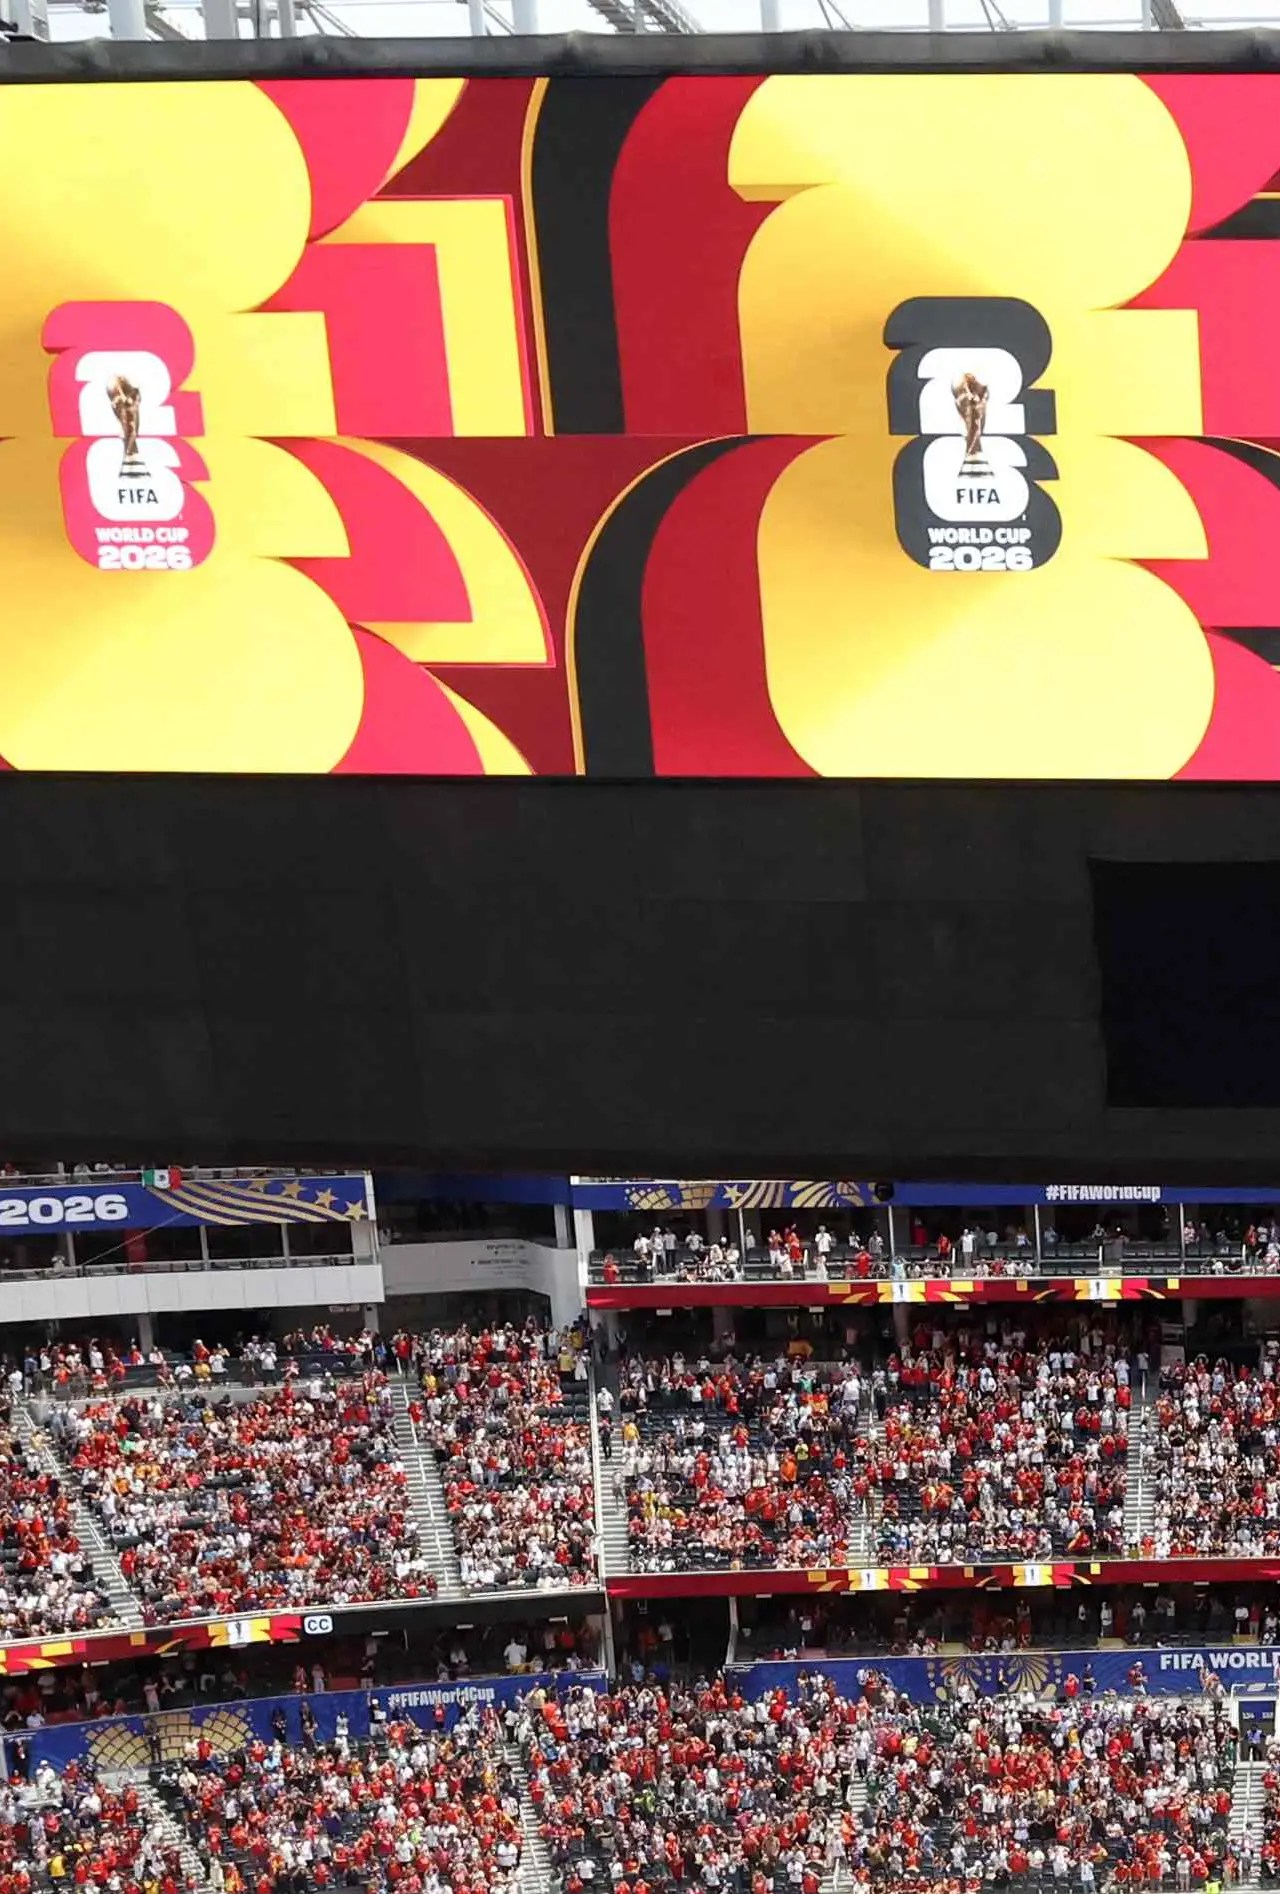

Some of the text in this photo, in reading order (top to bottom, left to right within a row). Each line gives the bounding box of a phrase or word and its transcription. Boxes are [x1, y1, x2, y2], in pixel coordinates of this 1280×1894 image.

[117, 489, 159, 504] FIFA
[956, 489, 1001, 504] FIFA
[95, 527, 189, 544] WORLD CUP
[927, 527, 1032, 545] WORLD CUP
[97, 546, 193, 570] 2026
[928, 546, 1034, 571] 2026
[0, 1194, 128, 1225] 2026
[308, 1618, 329, 1631] CC
[1160, 1653, 1204, 1670] FIFA
